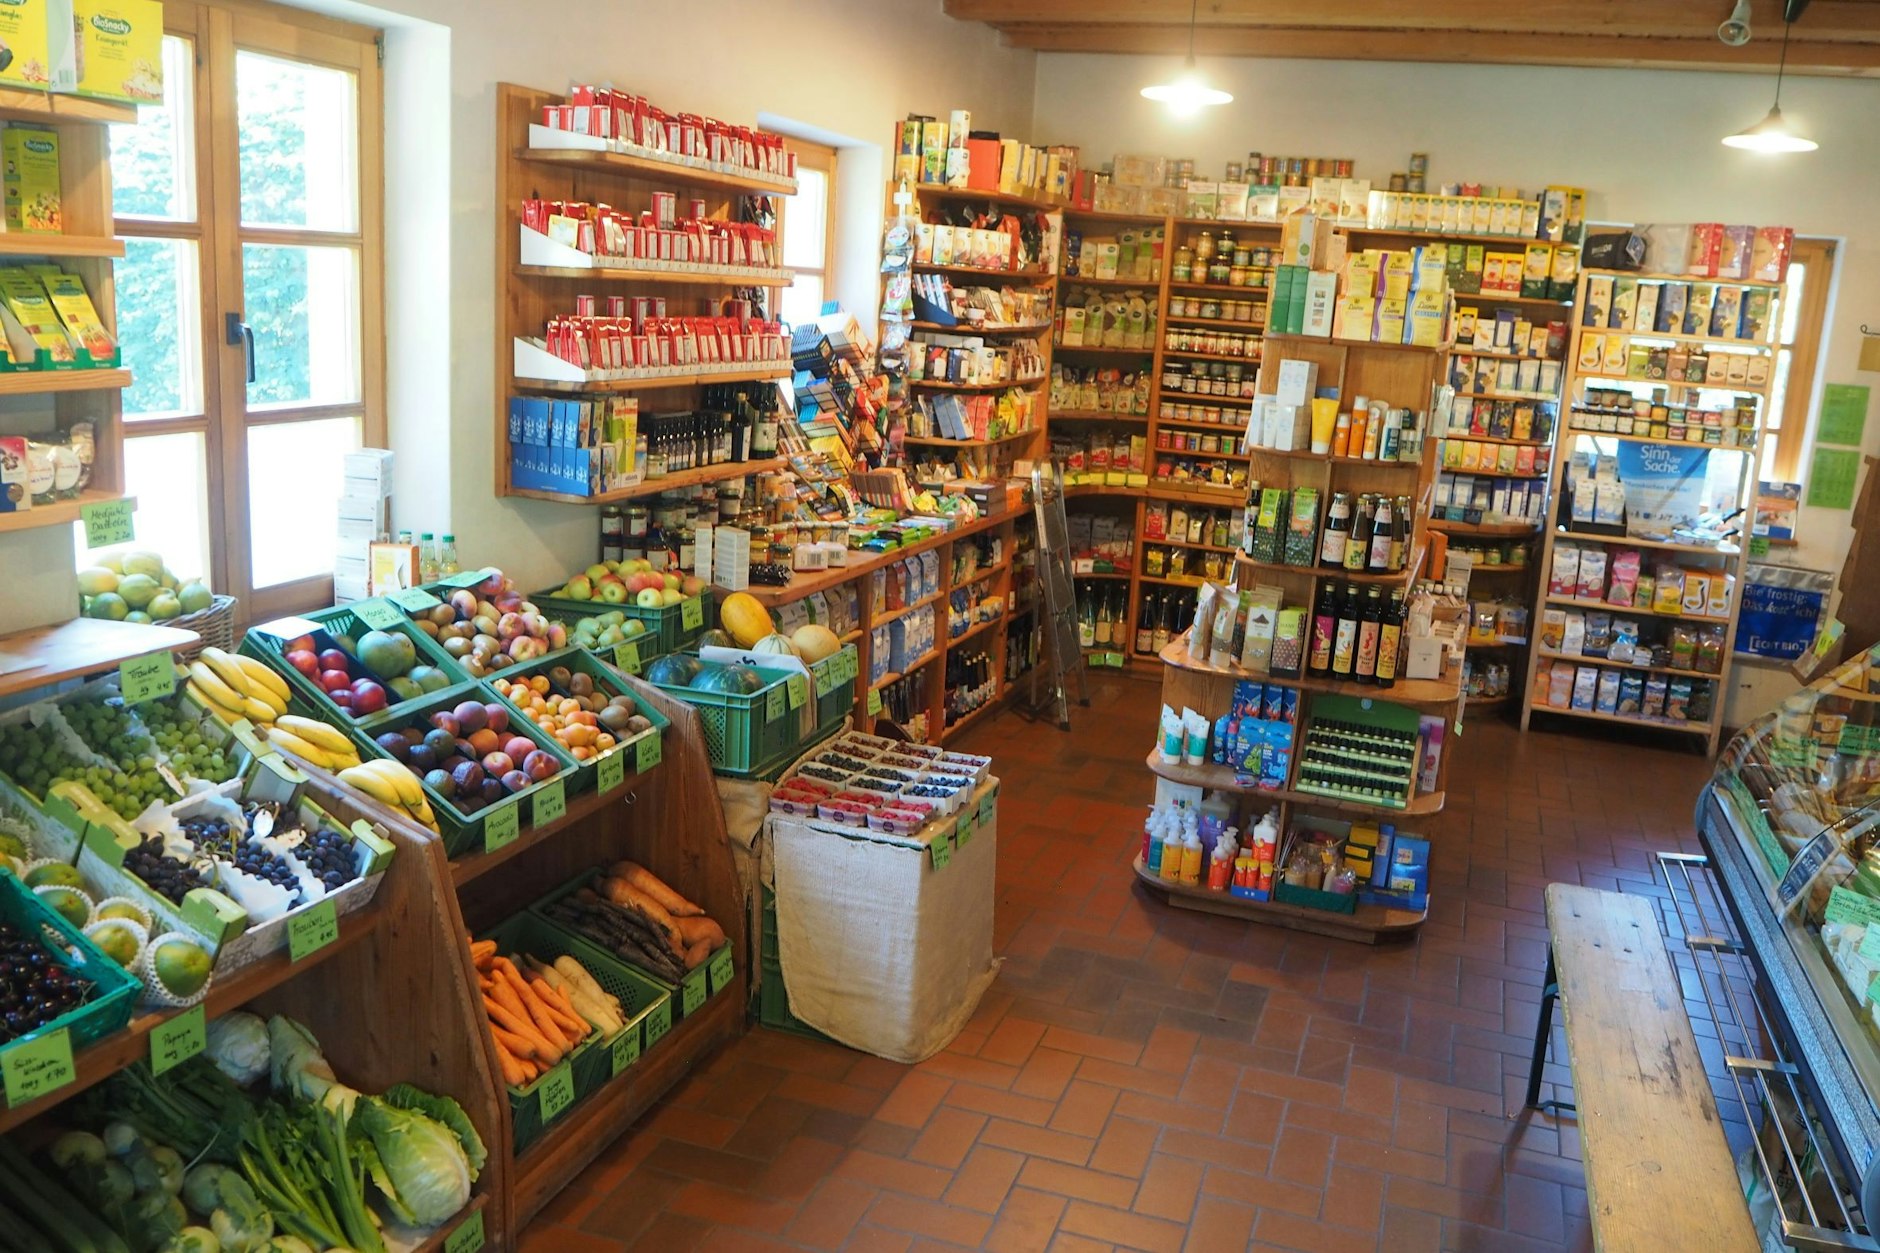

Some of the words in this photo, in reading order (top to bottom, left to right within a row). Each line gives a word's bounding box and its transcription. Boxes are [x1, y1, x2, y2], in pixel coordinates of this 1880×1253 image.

[1641, 445, 1670, 460] Sinn
[1670, 456, 1682, 464] der
[1643, 459, 1680, 474] Sache.
[1742, 599, 1763, 611] Das
